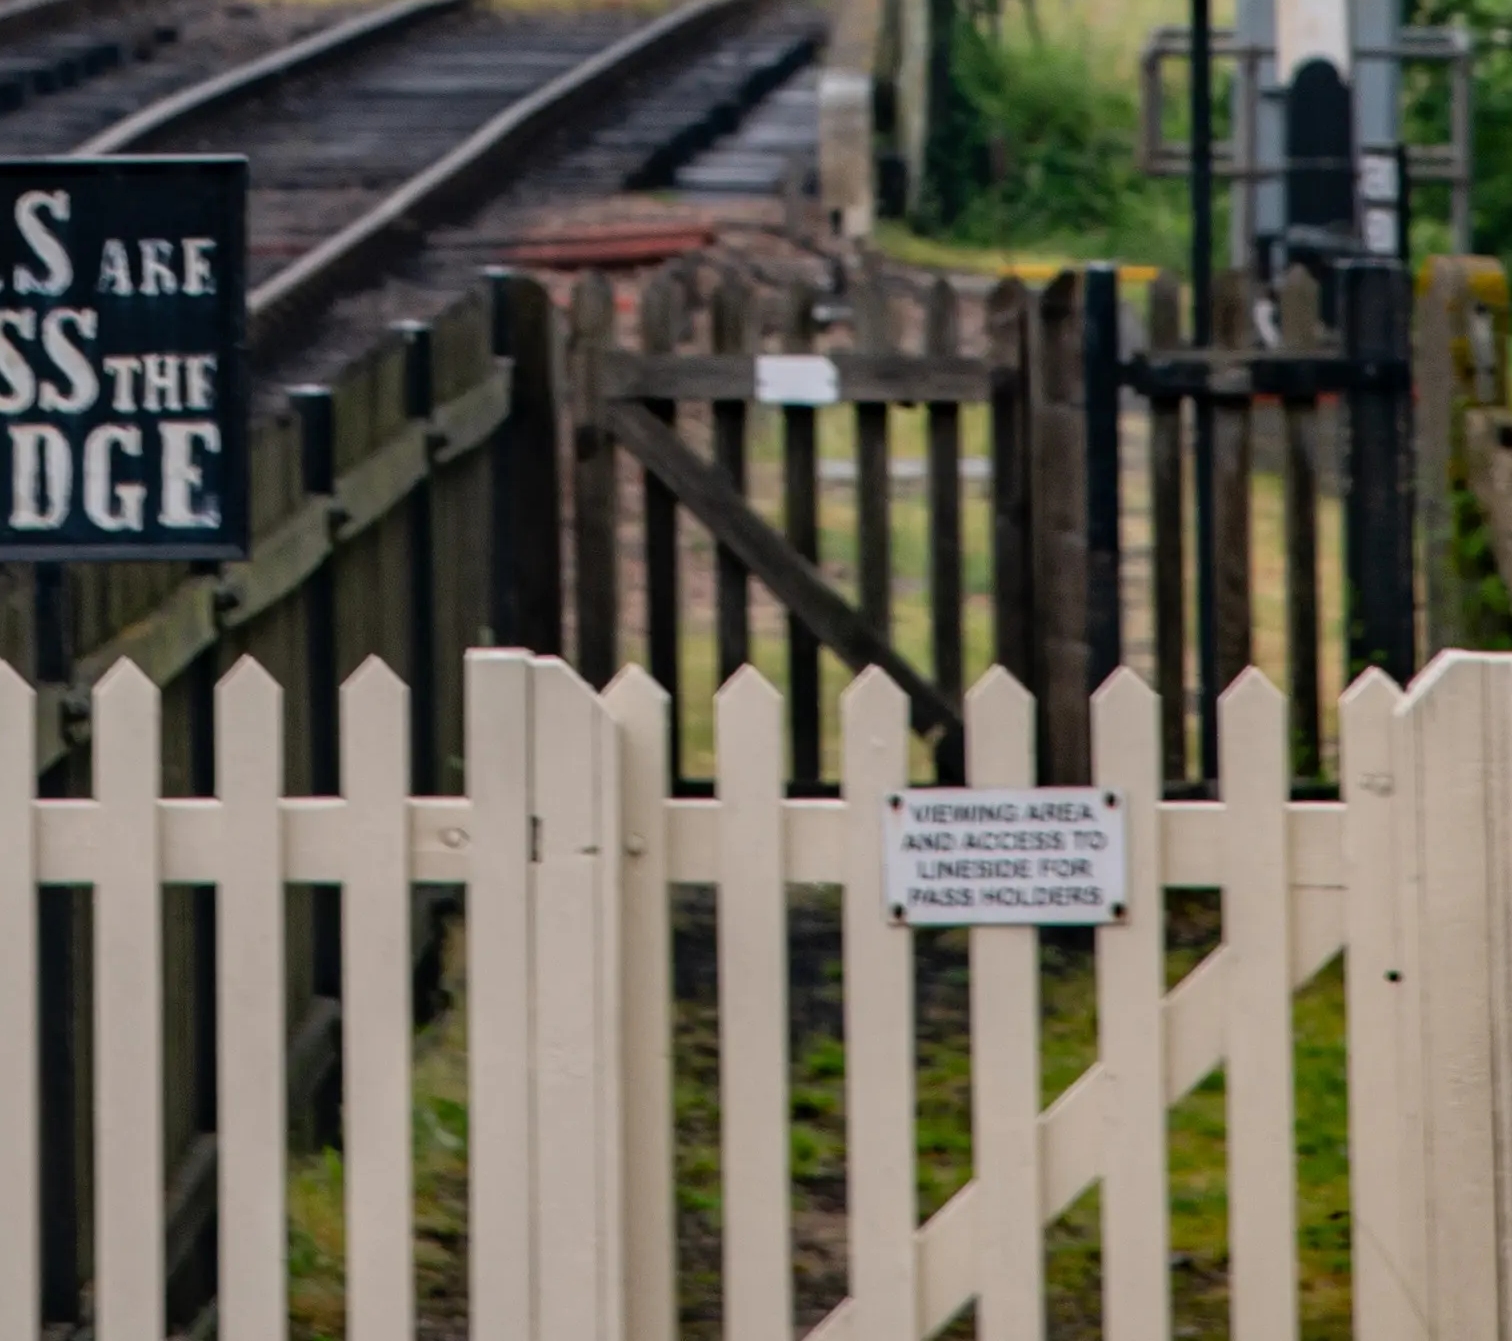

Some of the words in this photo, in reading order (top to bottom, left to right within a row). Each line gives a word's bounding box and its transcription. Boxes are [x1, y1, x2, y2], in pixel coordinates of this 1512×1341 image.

[97, 237, 219, 297] ARE
[103, 353, 219, 413] THE
[911, 803, 1018, 824] VIEWING
[1024, 802, 1097, 822] AREA
[902, 831, 957, 852] AND
[961, 829, 1065, 851] ACCESS
[1071, 829, 1109, 850] TO
[916, 858, 1032, 880] LINESIDE
[1036, 857, 1094, 879] FOR
[907, 887, 976, 907] PASS
[979, 885, 1104, 907] HOLDERS
